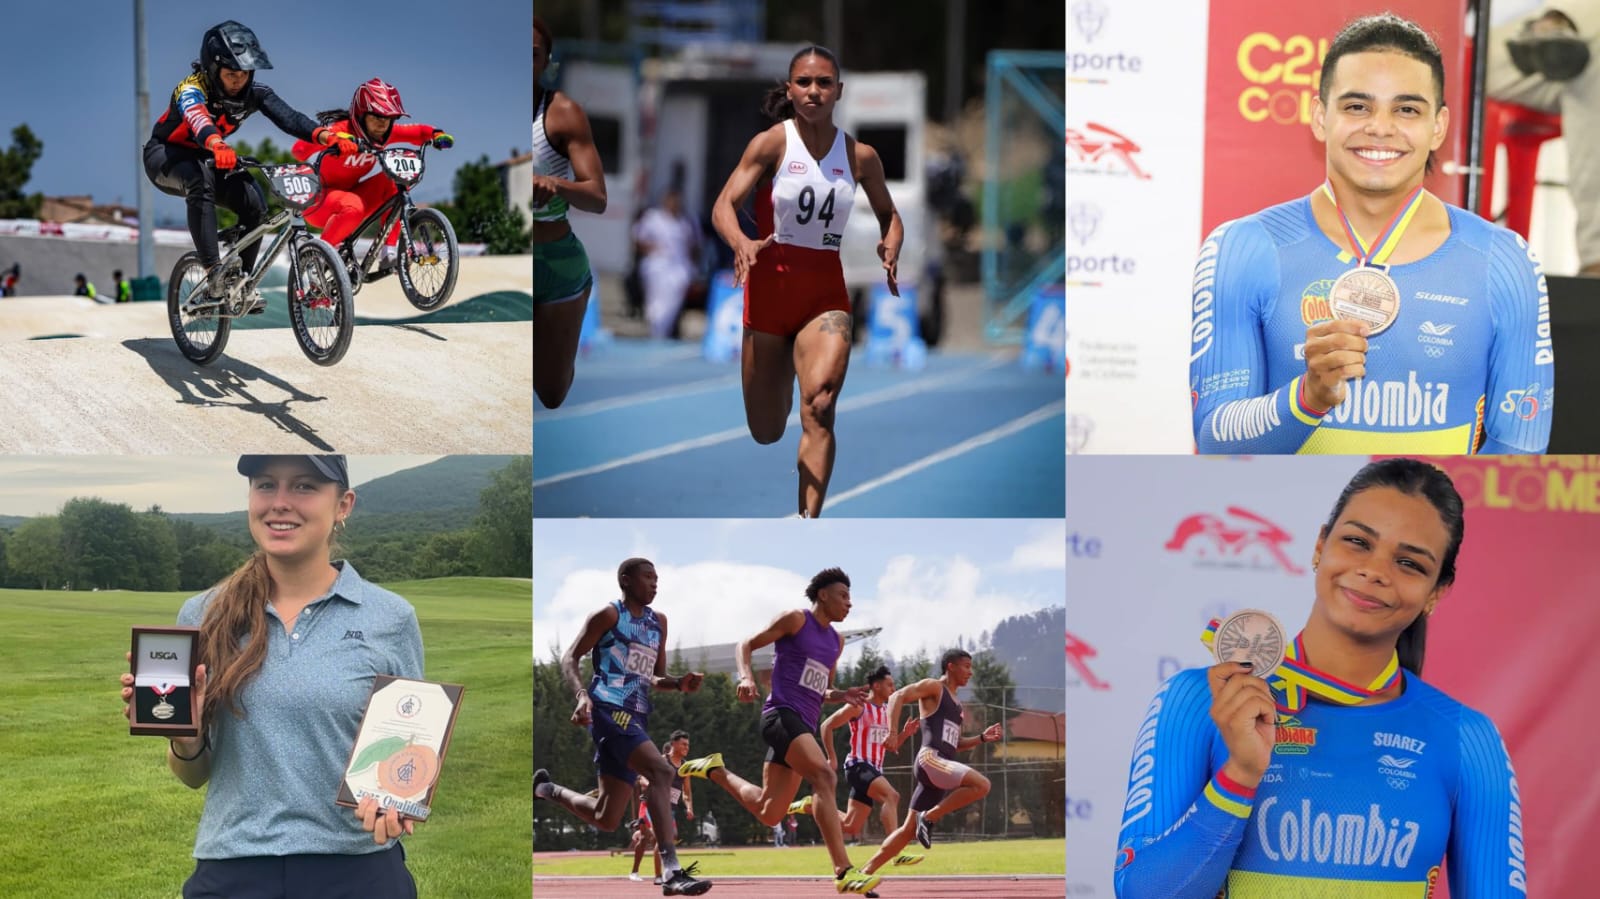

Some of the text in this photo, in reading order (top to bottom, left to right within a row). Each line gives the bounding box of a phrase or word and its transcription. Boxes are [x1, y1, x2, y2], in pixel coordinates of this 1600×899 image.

[394, 158, 416, 172] 204
[283, 176, 311, 195] 506
[795, 185, 836, 229] 94
[1415, 291, 1469, 306] SUAREZ
[1417, 335, 1454, 346] COLOMBIA
[1324, 370, 1449, 427] olombia
[150, 651, 178, 660] USGA
[628, 652, 655, 678] 305
[804, 668, 827, 694] 080
[1373, 732, 1427, 755] SUAREZ
[1378, 767, 1417, 779] COLOMBIA
[1257, 797, 1420, 868] Colombia
